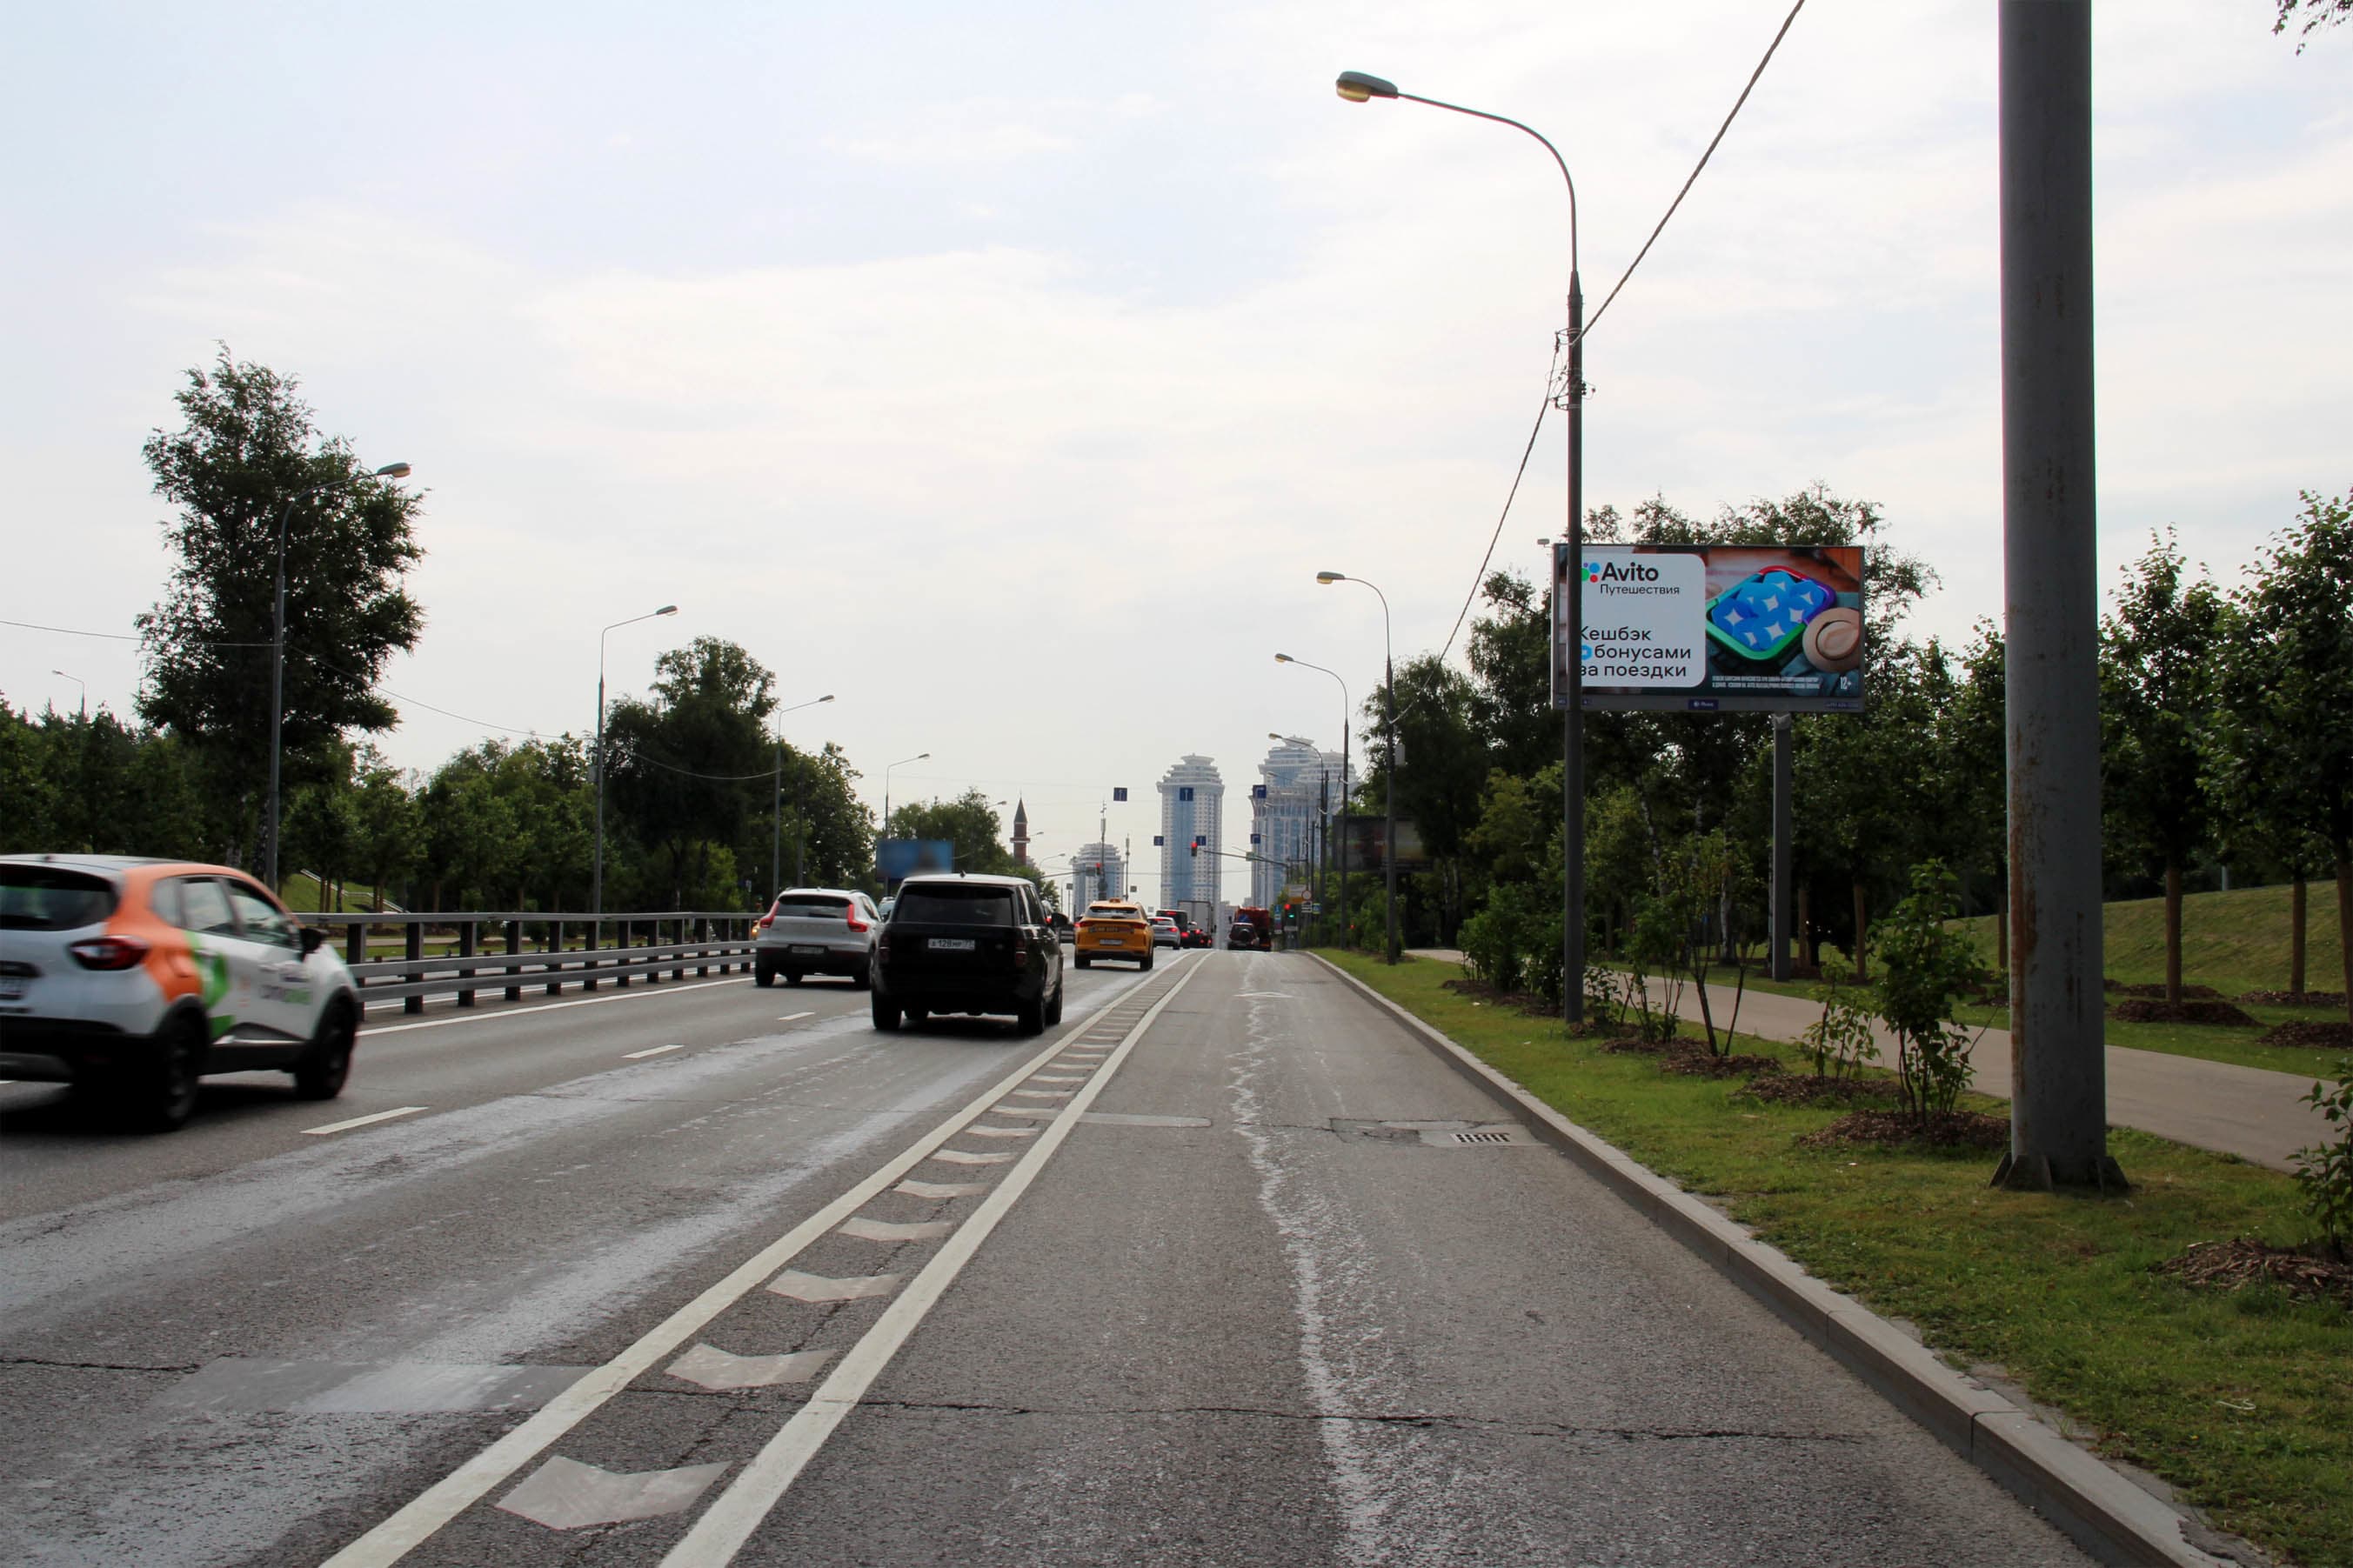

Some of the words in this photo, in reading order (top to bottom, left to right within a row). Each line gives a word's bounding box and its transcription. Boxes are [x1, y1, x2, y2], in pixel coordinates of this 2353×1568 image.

[1601, 562, 1660, 582] Avito
[1600, 584, 1681, 597] Путешествия
[1594, 644, 1691, 663] бонусами
[1604, 665, 1687, 679] поездки
[1840, 676, 1852, 690] 12+
